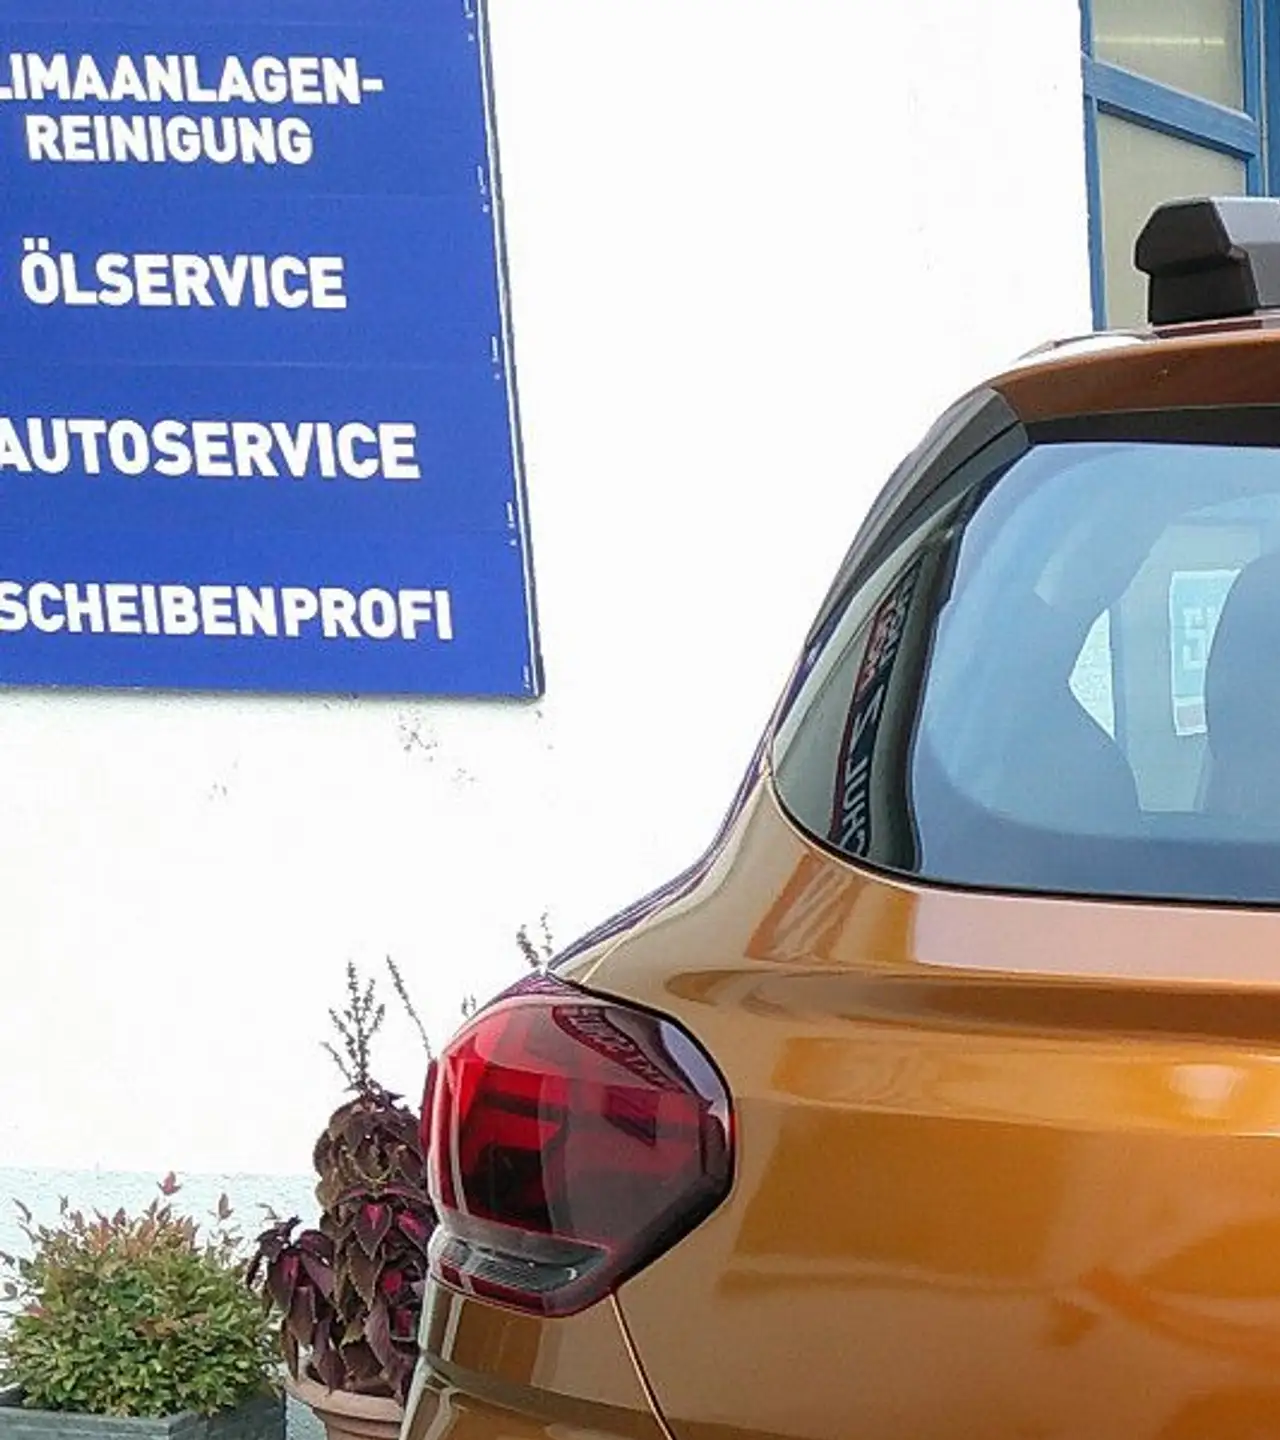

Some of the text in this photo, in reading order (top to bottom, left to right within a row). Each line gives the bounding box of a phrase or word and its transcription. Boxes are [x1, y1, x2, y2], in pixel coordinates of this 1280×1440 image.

[25, 114, 313, 165] REINIGUNG
[21, 237, 347, 309] ÖLSERVICE
[0, 417, 421, 479] AUTOSERVICE
[0, 581, 453, 640] SCHEIBENPROFI
